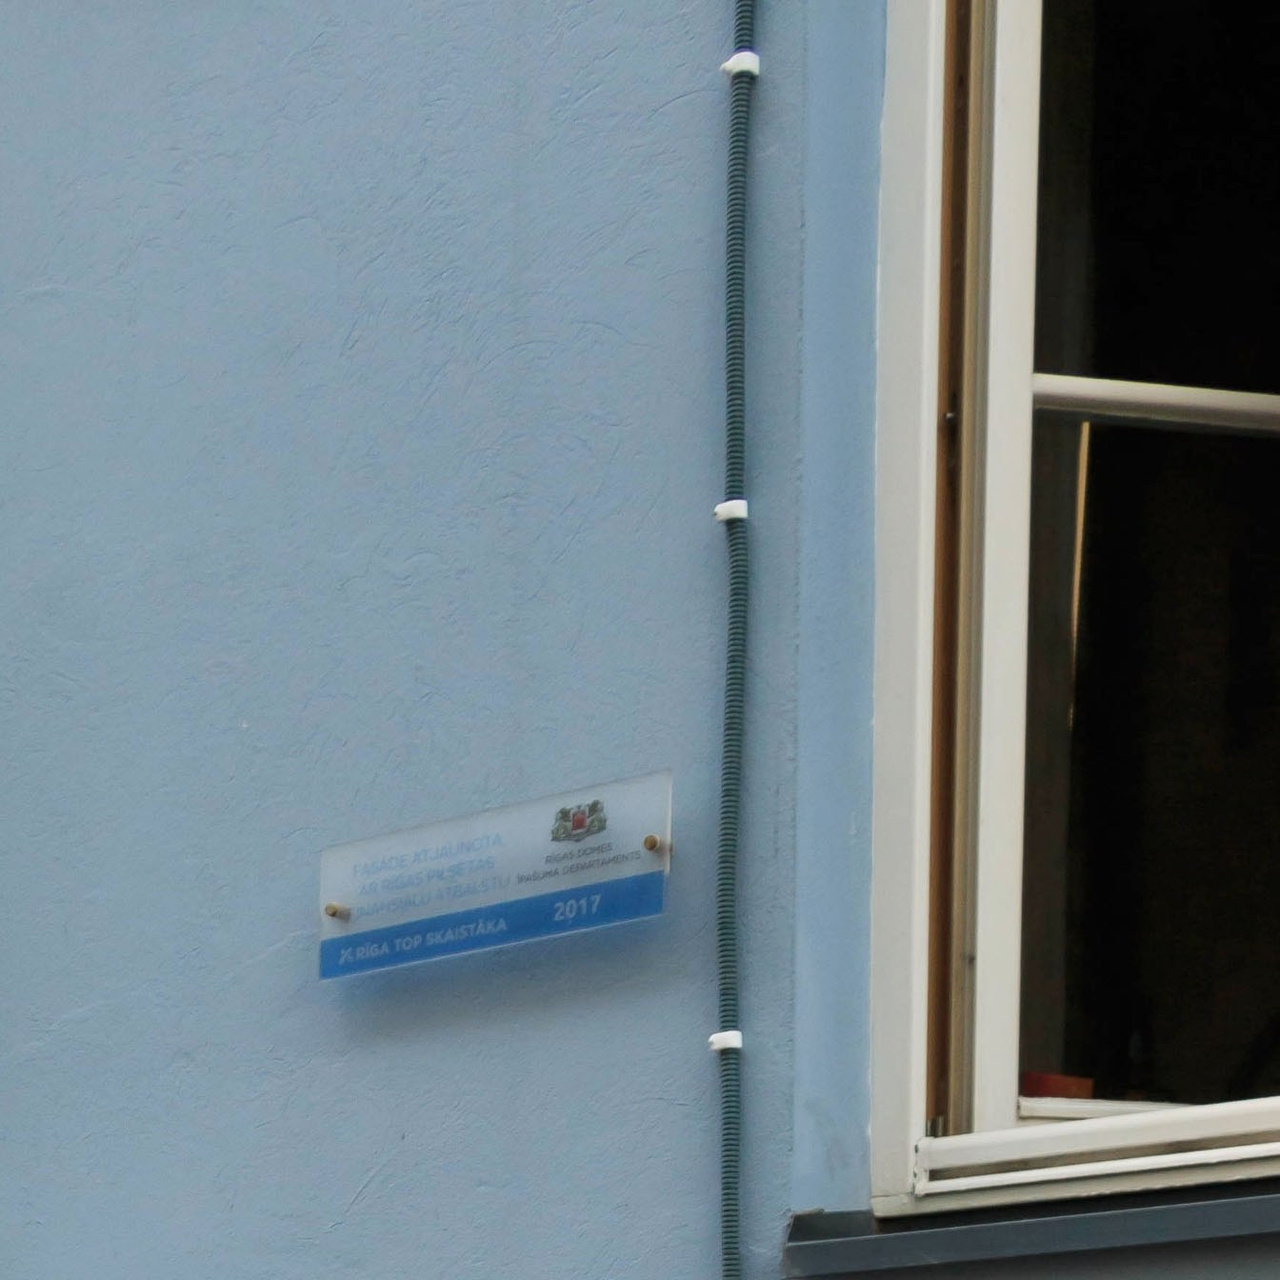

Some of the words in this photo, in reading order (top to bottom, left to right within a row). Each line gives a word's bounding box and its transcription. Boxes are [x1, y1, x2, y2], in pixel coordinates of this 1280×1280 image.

[554, 894, 601, 921] 2017
[356, 940, 389, 960] RĪGA
[394, 935, 422, 953] TOP
[426, 916, 508, 947] SKAISTĀKA
